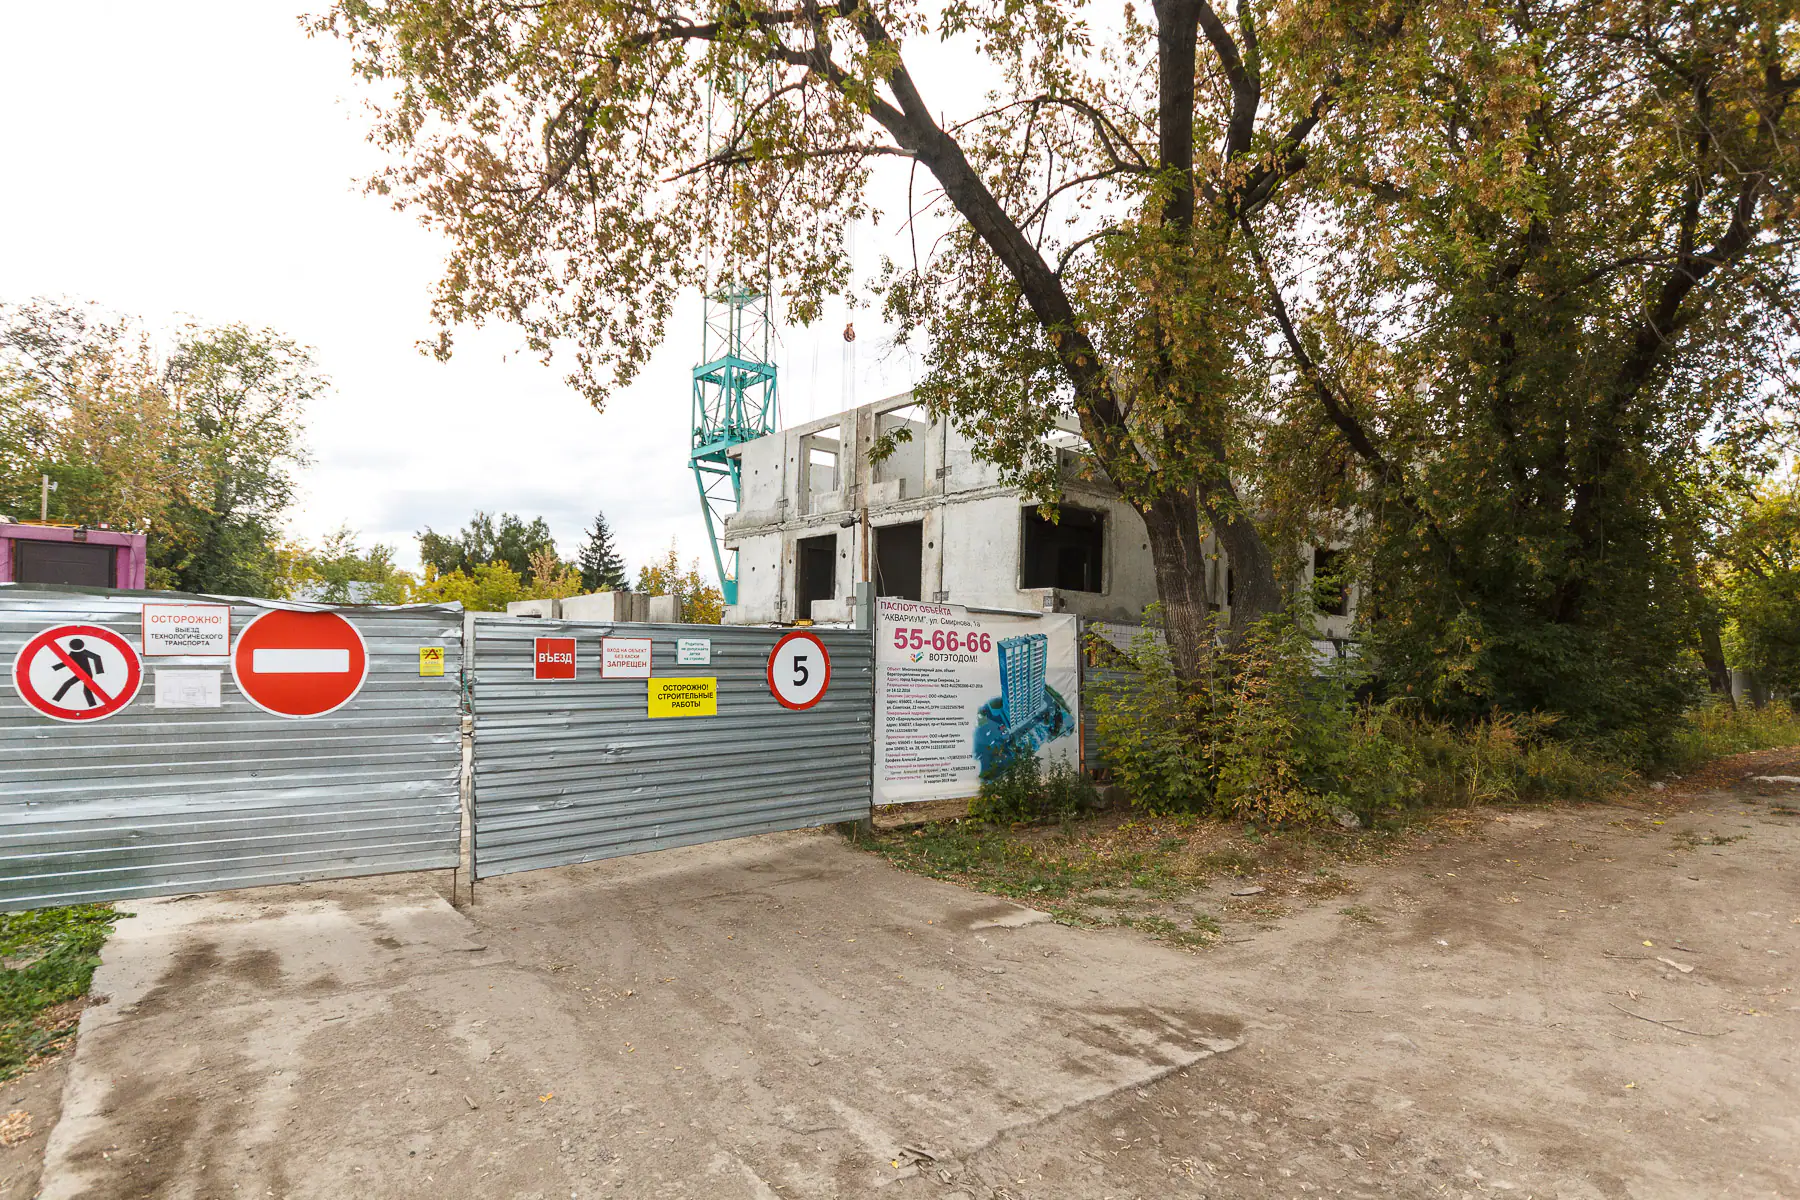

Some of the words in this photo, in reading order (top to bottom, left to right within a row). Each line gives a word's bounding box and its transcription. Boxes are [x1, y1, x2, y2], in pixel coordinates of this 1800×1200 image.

[880, 601, 918, 613] ПАСПОРТ
[919, 605, 953, 616] ОБЪЕКТА
[151, 615, 222, 624] ОСТОРОЖНО!
[940, 618, 972, 627] Смирнова,
[893, 628, 991, 653] 55-66-66
[538, 653, 573, 665] ВЪЕЗД
[929, 653, 978, 663] ВОТЭТОДОМ!
[606, 660, 647, 668] ЗАПРЕЩЕН
[792, 655, 809, 687] 5
[663, 684, 709, 692] ОСТОРОЖНО!
[657, 692, 714, 700] СТРОИТЕЛЬНЫЕ
[671, 700, 701, 708] РАБОТЫ
